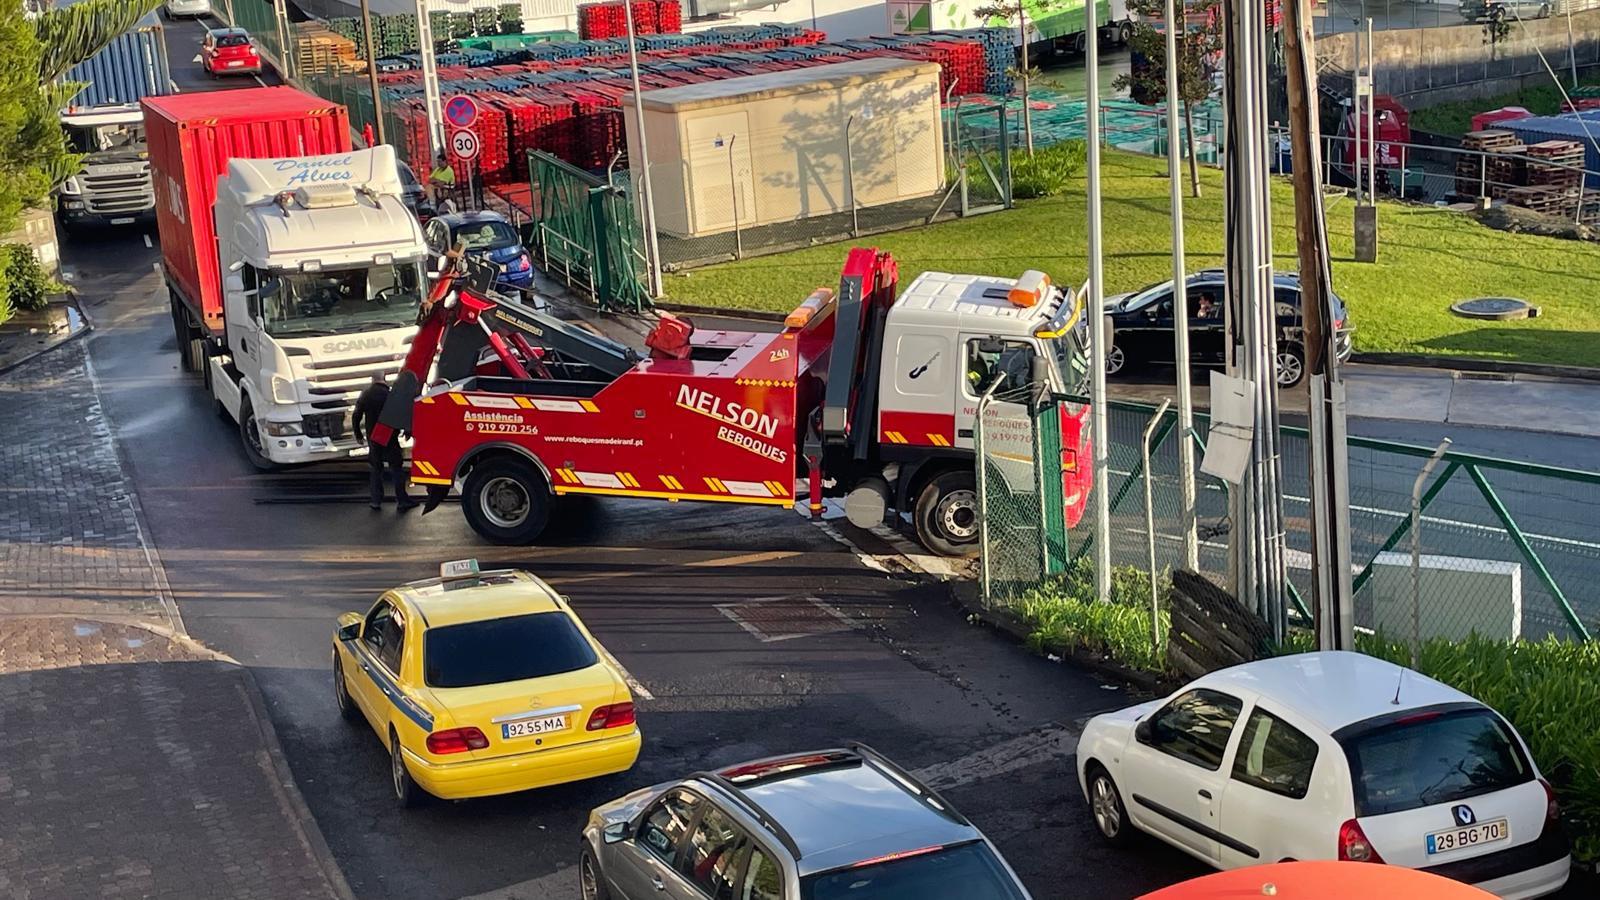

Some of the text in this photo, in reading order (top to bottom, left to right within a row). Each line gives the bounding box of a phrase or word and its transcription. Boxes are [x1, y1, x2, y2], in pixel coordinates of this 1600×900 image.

[456, 138, 473, 151] 30
[273, 156, 352, 171] Daniel
[287, 169, 352, 186] Alves
[322, 337, 388, 354] SCANIA
[770, 348, 790, 361] 24h
[463, 410, 524, 423] Assistência
[676, 383, 779, 439] NELSON
[963, 407, 999, 417] NEON
[478, 423, 539, 434] 919 970 256
[717, 426, 788, 463] REBOQUES
[452, 561, 470, 571] TAXI
[509, 723, 524, 736] 92
[526, 721, 542, 733] 55
[544, 717, 564, 731] MA
